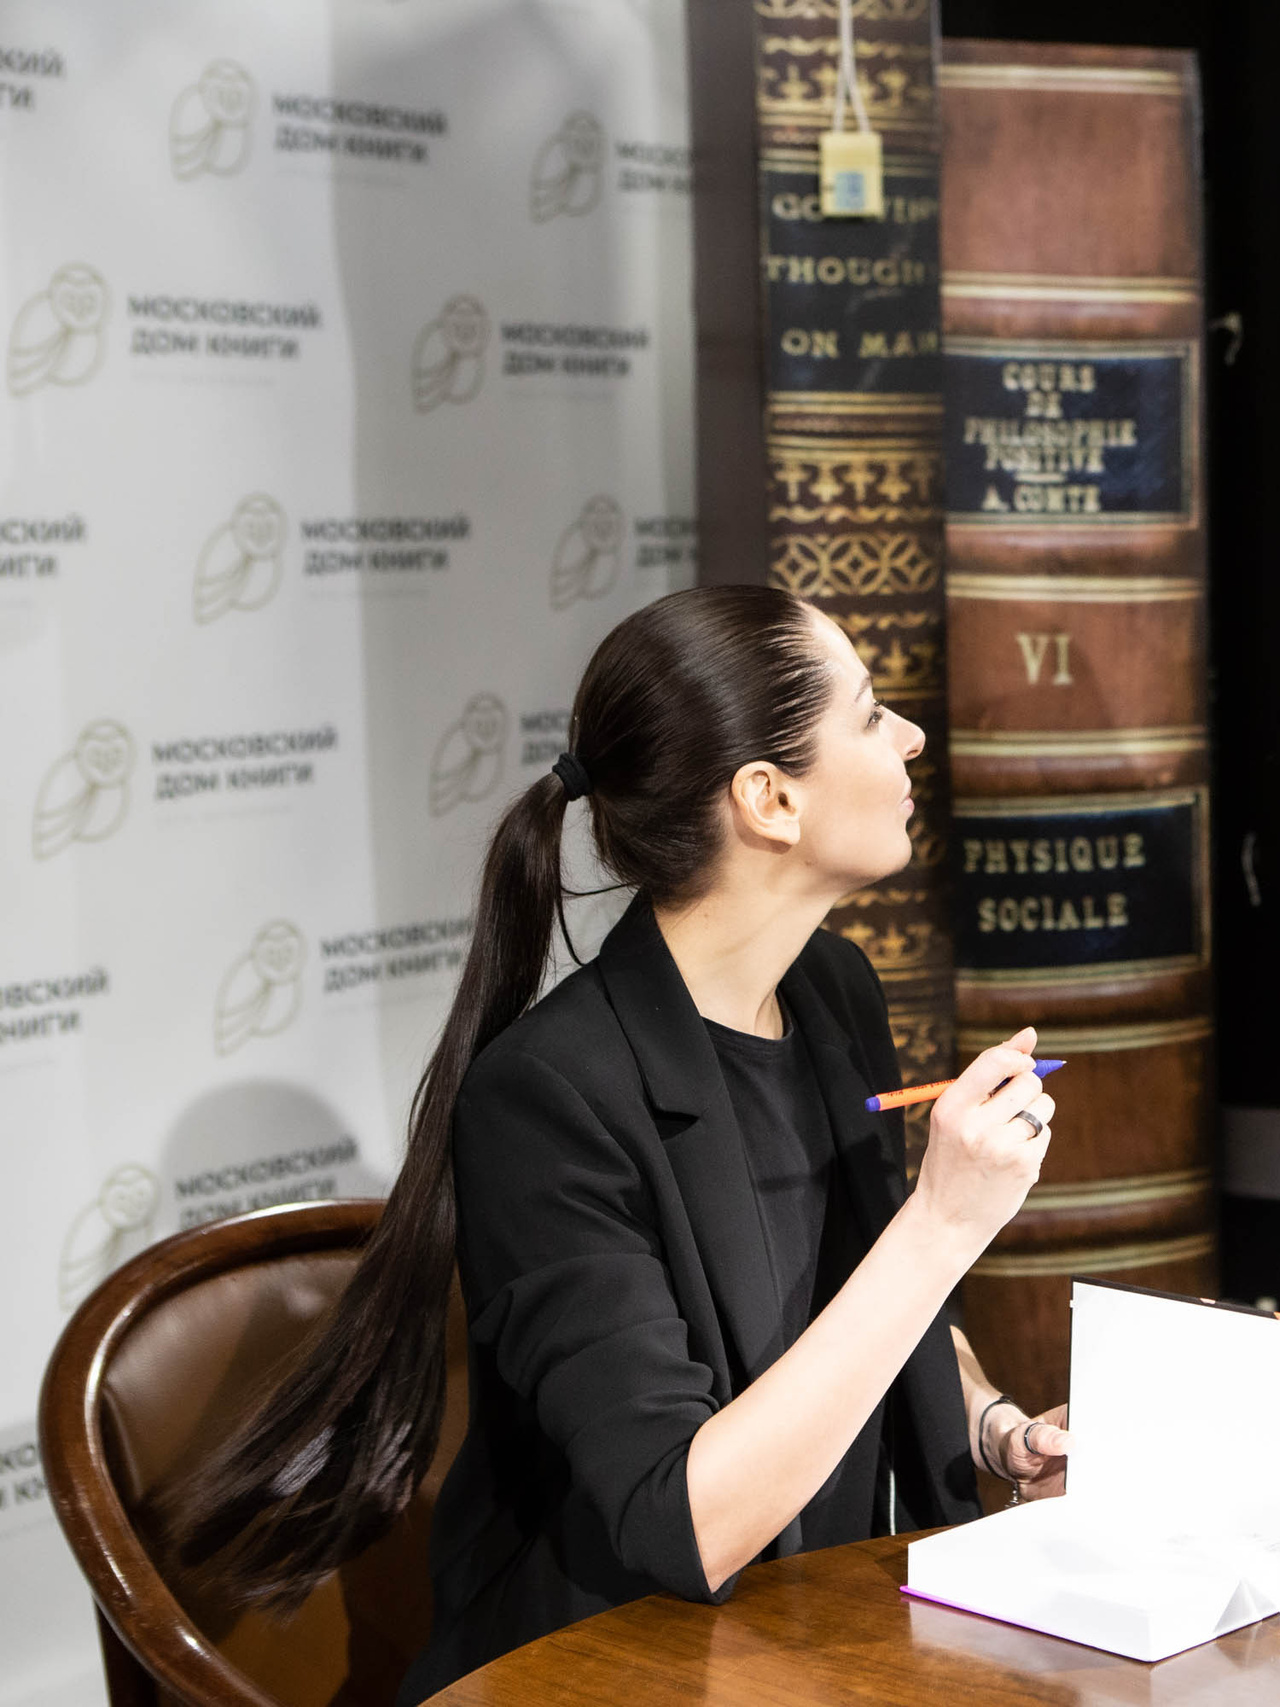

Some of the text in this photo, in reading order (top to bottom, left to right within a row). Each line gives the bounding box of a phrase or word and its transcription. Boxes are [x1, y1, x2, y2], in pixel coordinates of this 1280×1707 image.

[273, 94, 448, 136] МОСКОВСКИЙ
[276, 125, 429, 163] ДОМ КНИГИ
[127, 297, 321, 330] МОСКОВСКИЙ
[132, 329, 300, 361] ДОМ КНИГИ
[502, 323, 650, 350] МОСКОВСКИЙ
[780, 328, 840, 358] ON
[504, 351, 631, 378] ДОМ КНИГИ
[301, 513, 471, 543] МОСКОВСКИЙ
[304, 547, 448, 576] ДОМ КНИГИ
[1014, 632, 1074, 687] VI
[152, 722, 338, 763] МОСКОВСКИЙ
[155, 761, 313, 801] ДОМ КНИГИ
[963, 833, 1146, 874] PHYSIQUE
[978, 892, 1129, 932] SOCIALE
[324, 948, 462, 993] ДОМ КНИГИ
[175, 1137, 358, 1195] МОСКОВСКИЙ
